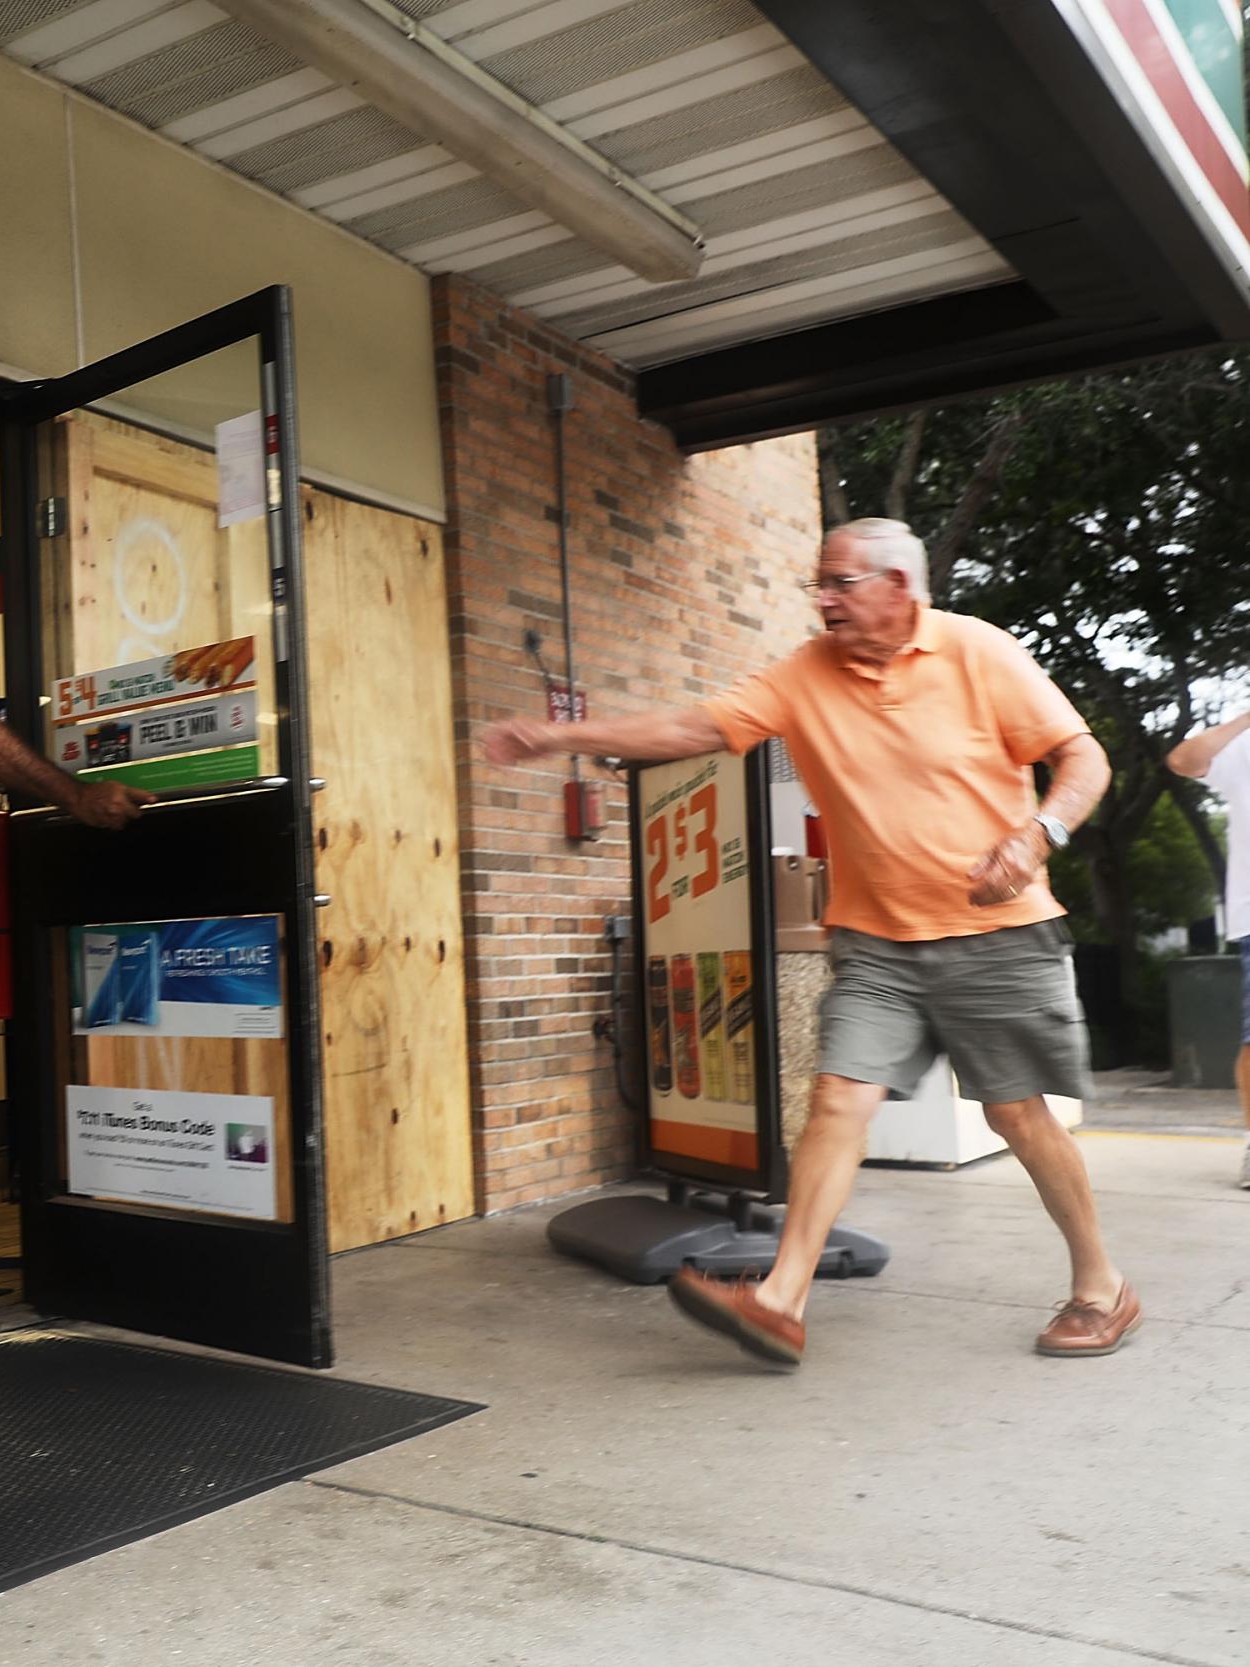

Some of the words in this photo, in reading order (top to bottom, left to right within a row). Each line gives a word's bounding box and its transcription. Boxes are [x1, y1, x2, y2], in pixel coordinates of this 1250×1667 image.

[646, 815, 671, 924] 2
[174, 948, 225, 966] FRESH
[227, 945, 272, 965] TAKE
[101, 1112, 137, 1129] iTunes
[139, 1115, 179, 1133] Bonus
[181, 1119, 216, 1136] Code
